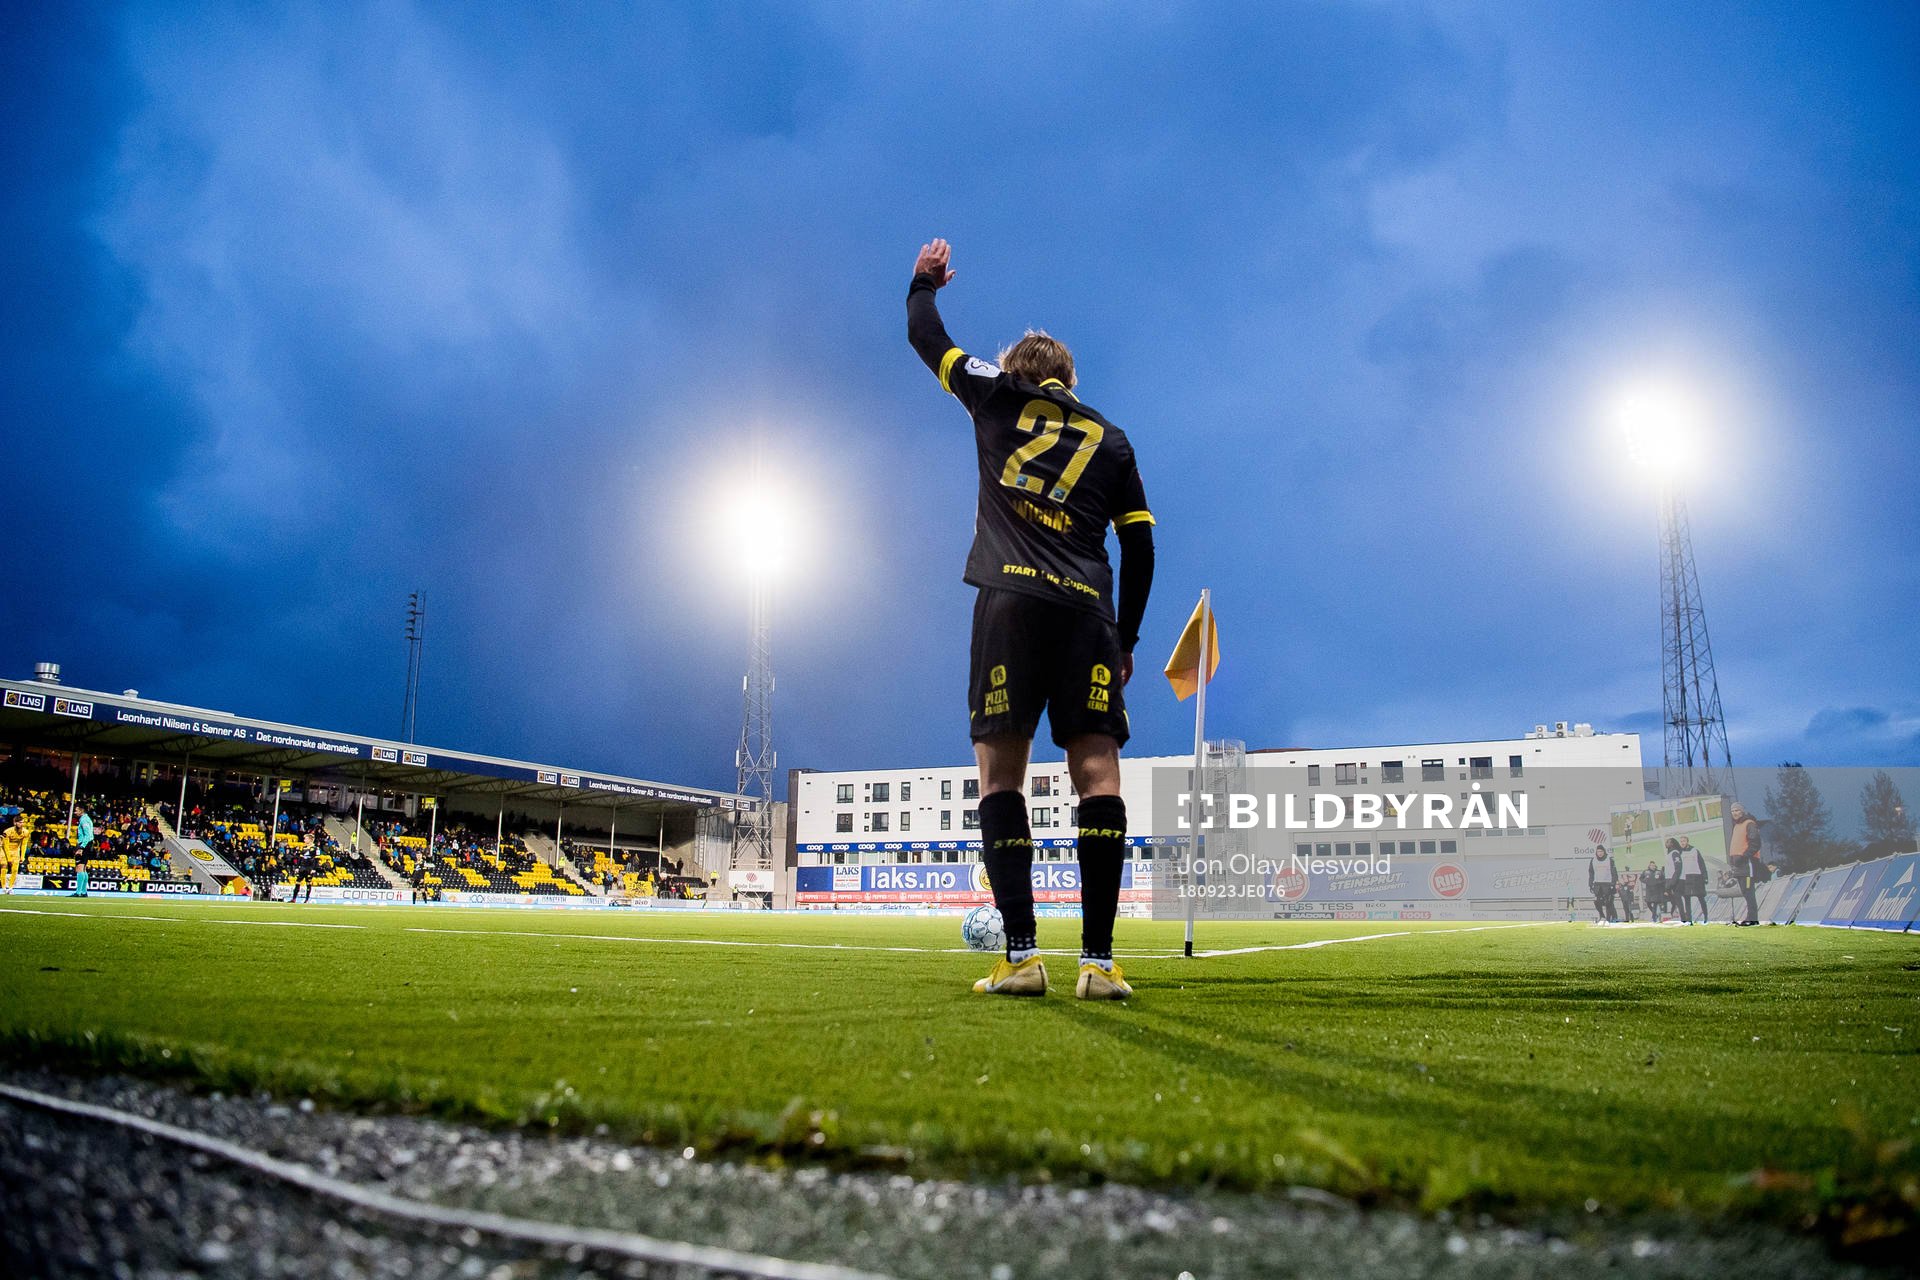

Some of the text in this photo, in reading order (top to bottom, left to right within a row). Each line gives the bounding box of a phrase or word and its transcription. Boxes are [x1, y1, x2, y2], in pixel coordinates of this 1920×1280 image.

[1000, 399, 1104, 503] 27
[1003, 564, 1037, 577] START
[1089, 685, 1109, 703] ZZA
[21, 696, 41, 707] LNS
[70, 704, 89, 715] LNS
[116, 710, 161, 726] Leonhard
[162, 717, 191, 731] Nilsen
[192, 722, 200, 732] &
[233, 728, 247, 739] AS
[256, 731, 272, 743] Det
[272, 735, 316, 750] nordnorske
[317, 741, 359, 755] alternativet
[382, 751, 396, 761] LNS
[412, 755, 426, 764] LNS
[1078, 827, 1123, 839] TART
[993, 838, 1033, 849] STAR
[1053, 839, 1074, 847] coop
[836, 867, 860, 875] LAKS
[1134, 863, 1163, 872] LAKS
[870, 867, 956, 889] laks.no
[1031, 865, 1082, 888] aks.
[68, 880, 118, 890] DDOR
[146, 882, 199, 894] DIADORA
[1280, 903, 1354, 911] TESS TESS
